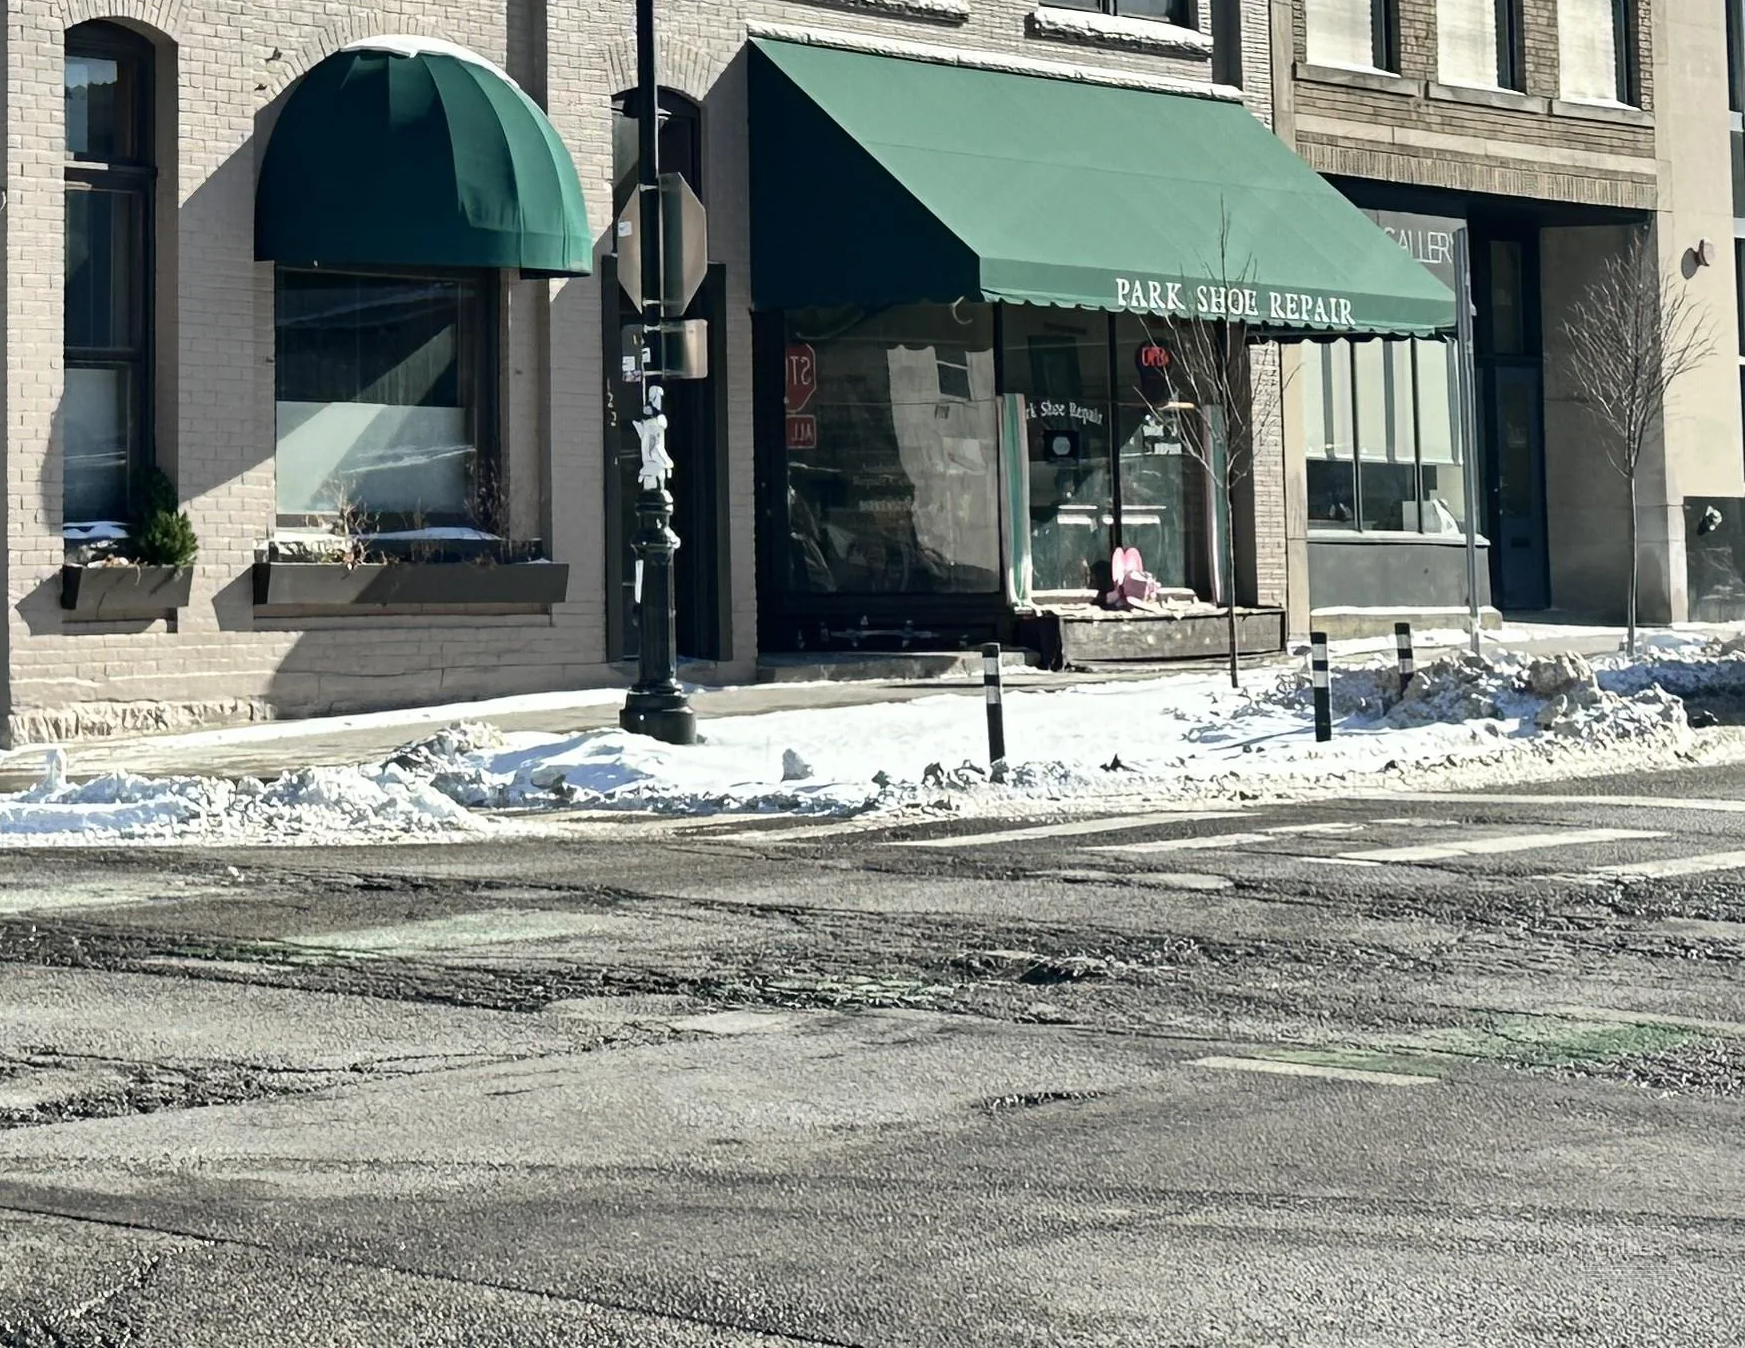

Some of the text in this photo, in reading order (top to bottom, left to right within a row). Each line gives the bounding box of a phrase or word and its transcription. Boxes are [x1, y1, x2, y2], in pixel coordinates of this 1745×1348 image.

[1116, 278, 1356, 325] PARK SHOE REPAIR
